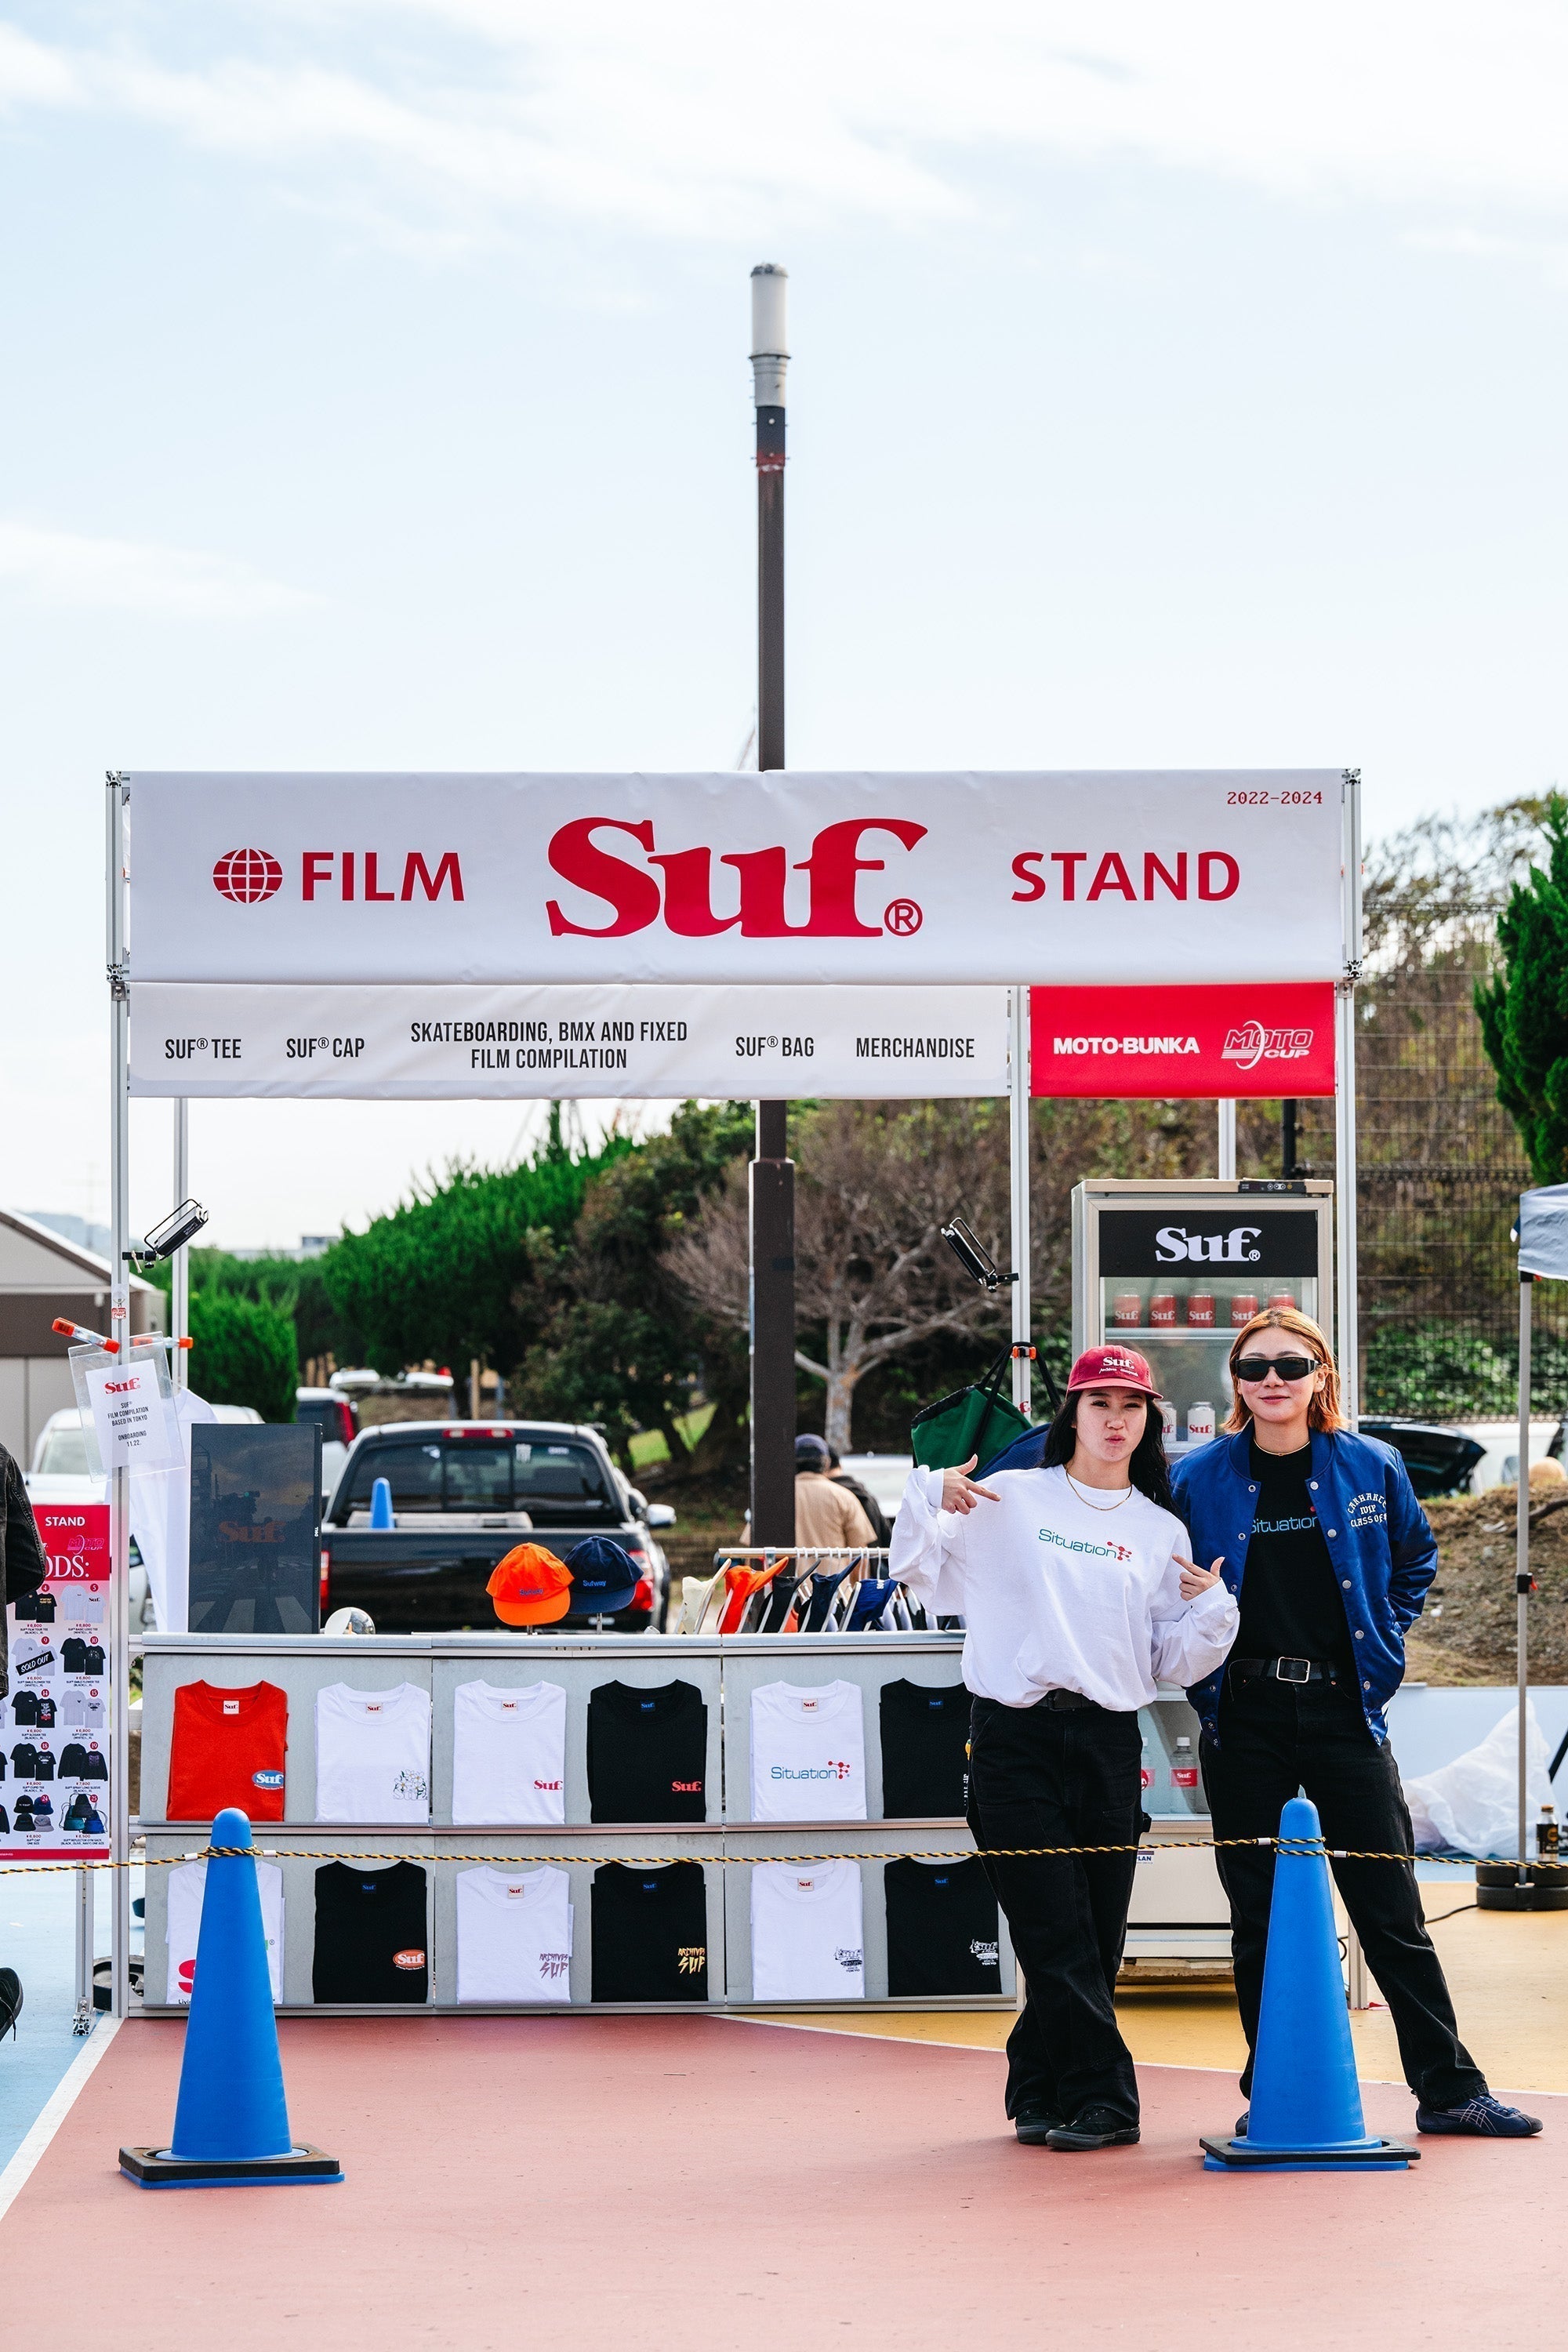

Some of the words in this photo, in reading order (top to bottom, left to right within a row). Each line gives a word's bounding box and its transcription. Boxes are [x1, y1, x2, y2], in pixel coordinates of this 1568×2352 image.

[1227, 791, 1323, 804] 2022-2024
[302, 851, 464, 902] FILM
[1011, 851, 1240, 902] STAND
[411, 1022, 553, 1045] SKATEBOARDING,
[559, 1022, 595, 1042] BMX
[601, 1022, 634, 1042] AND
[641, 1022, 688, 1042] FIXED
[1223, 1028, 1314, 1049] MOTO
[211, 1038, 241, 1059] TEE
[332, 1037, 365, 1058] CAP
[782, 1036, 814, 1057] BAG
[856, 1037, 975, 1058] MERCHANDISE
[1053, 1036, 1200, 1054] MOTO-BUNKA
[1263, 1049, 1310, 1058] CUP
[471, 1048, 510, 1069] FILM
[516, 1048, 626, 1069] COMPILATION
[107, 1410, 118, 1419] FILM
[119, 1406, 149, 1417] COMPILATION
[118, 1430, 147, 1441] ONBOARDING
[45, 1516, 85, 1527] STAND
[1350, 1515, 1374, 1527] CLASS
[1374, 1513, 1384, 1523] OF
[1038, 1528, 1117, 1559] Situation
[20, 1659, 36, 1673] SOLD
[37, 1654, 49, 1664] OUT
[771, 1766, 837, 1780] Situation
[539, 1961, 568, 1980] SUF
[677, 1956, 706, 1974] SUF
